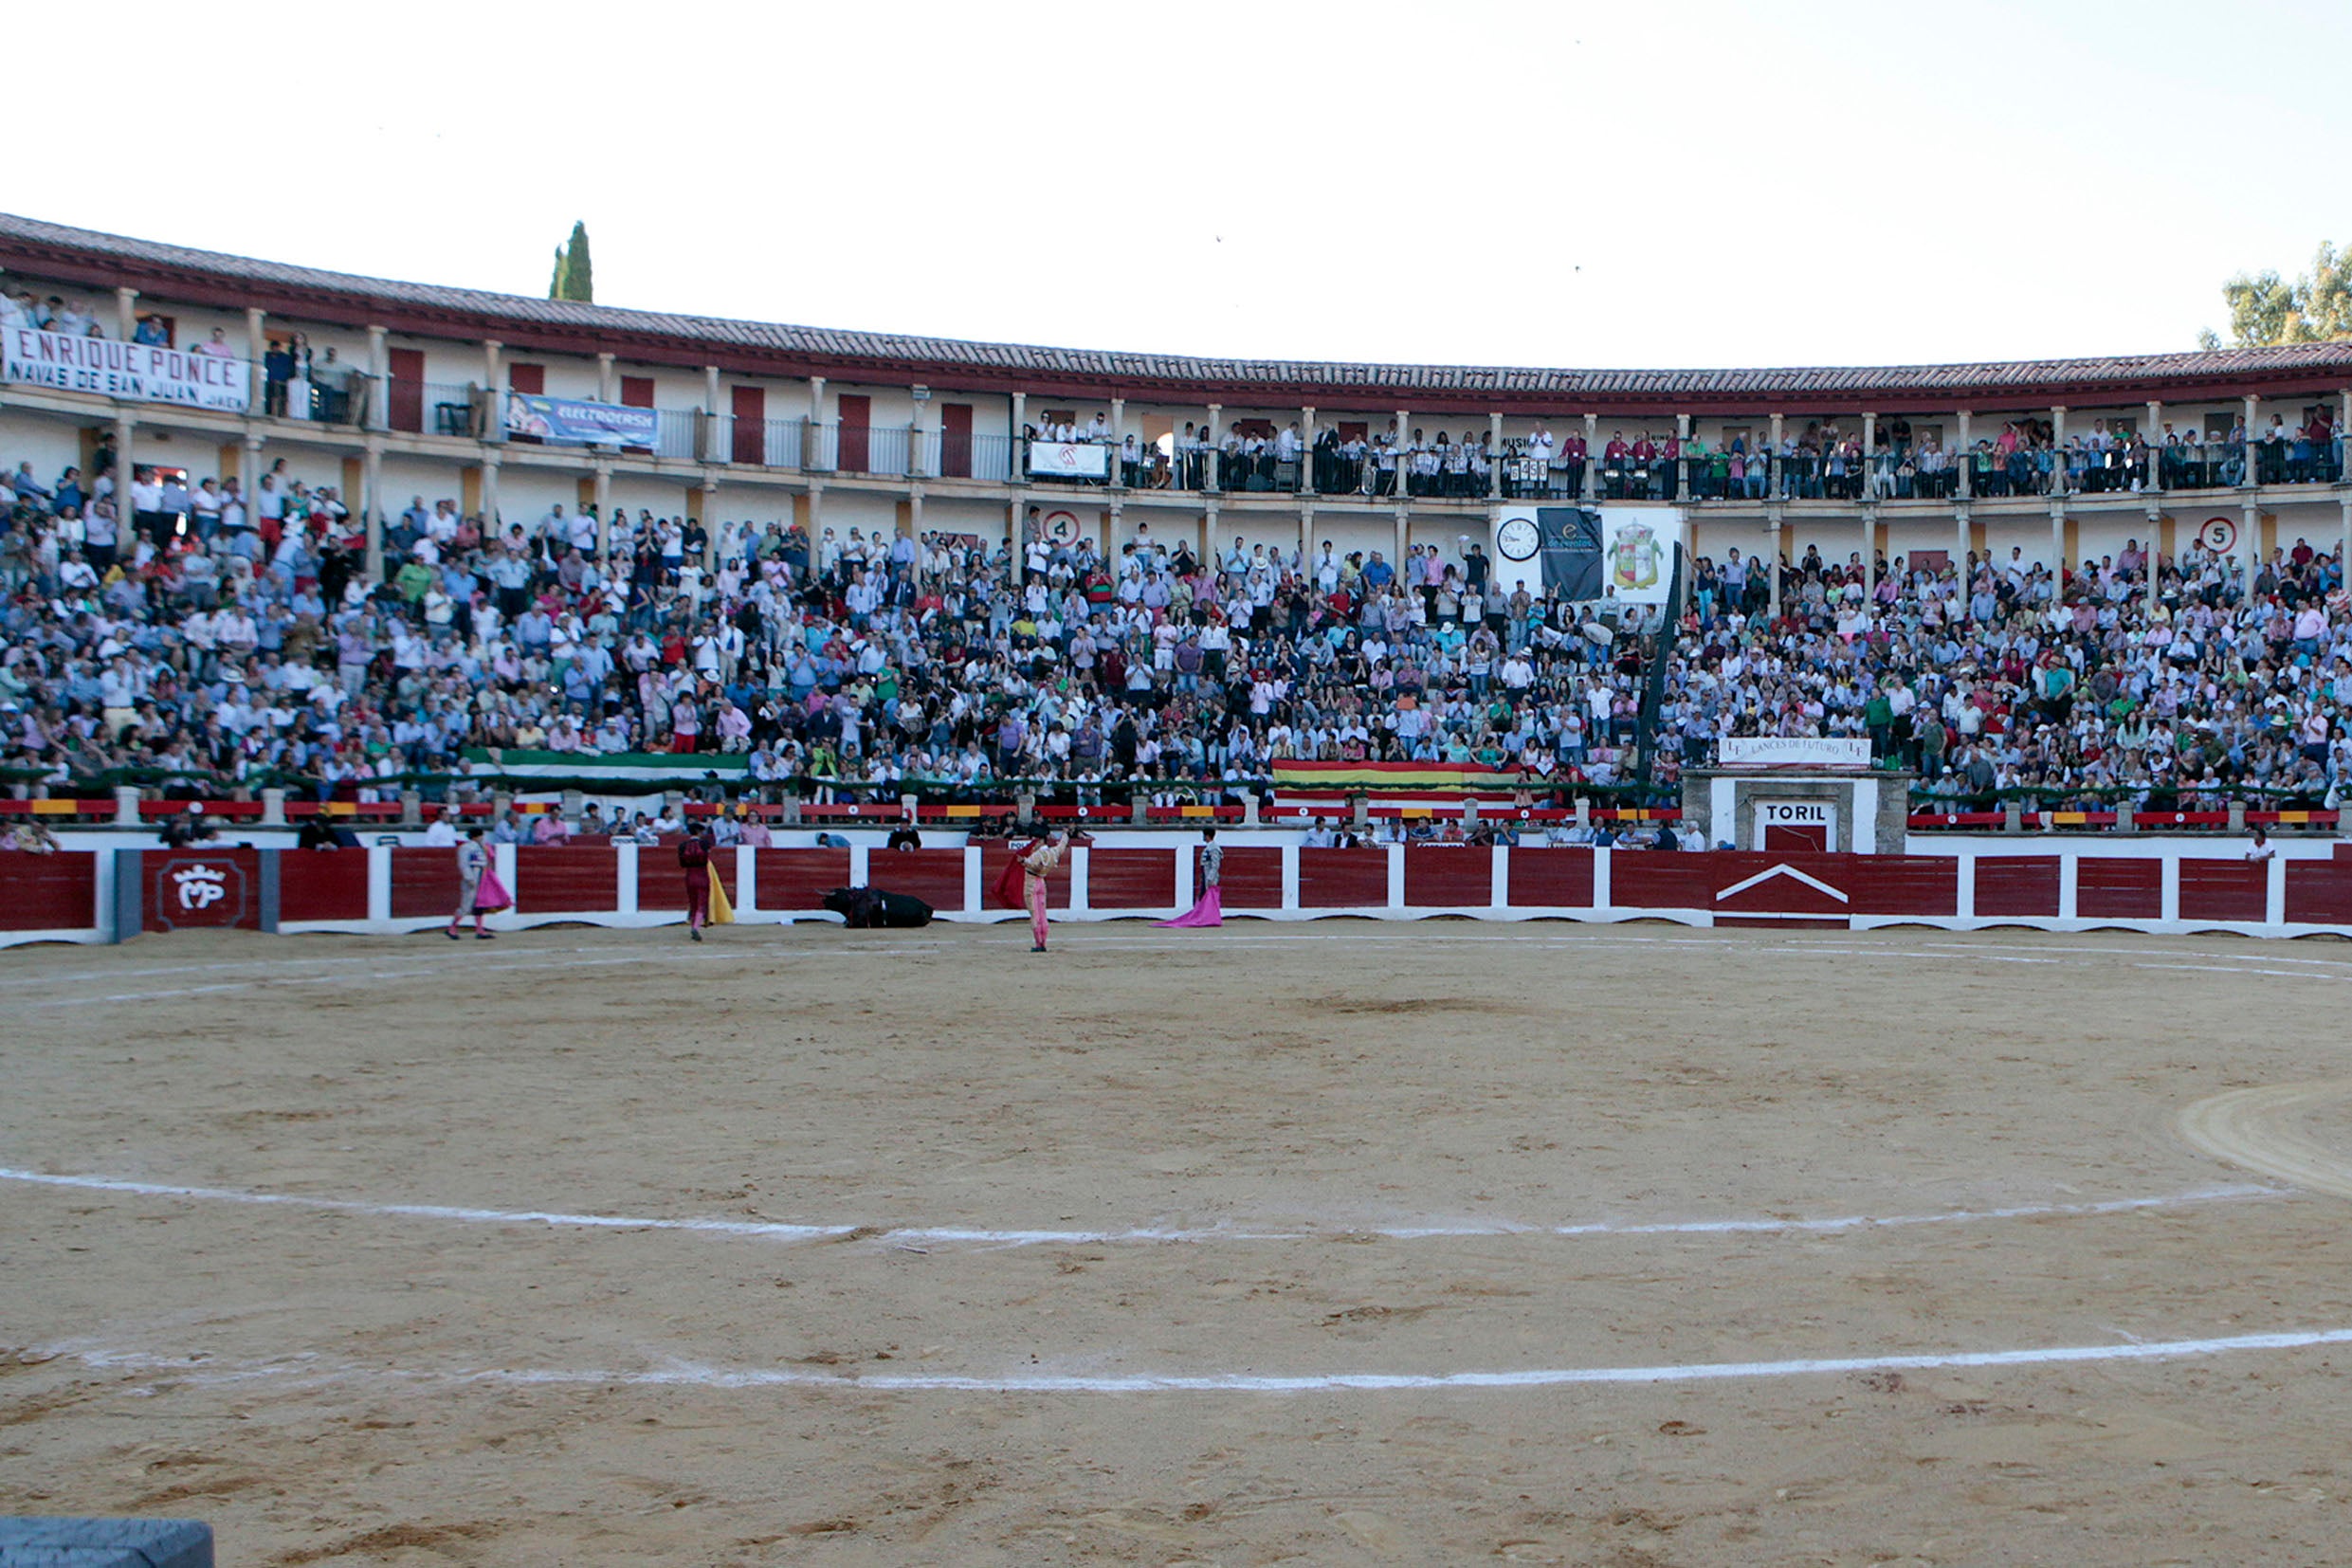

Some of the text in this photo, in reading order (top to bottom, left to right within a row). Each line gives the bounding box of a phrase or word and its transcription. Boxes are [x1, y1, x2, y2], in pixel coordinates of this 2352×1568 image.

[19, 330, 237, 387] ENRIQUE PONCE
[9, 361, 69, 386] NAVAS
[76, 369, 100, 390] DE
[108, 374, 142, 395] SAN
[151, 382, 199, 402] JUAN
[1054, 520, 1068, 538] 4
[2212, 527, 2225, 543] 5
[1751, 739, 1840, 755] LANCES DE FUTURO
[1767, 806, 1825, 820] TORIL
